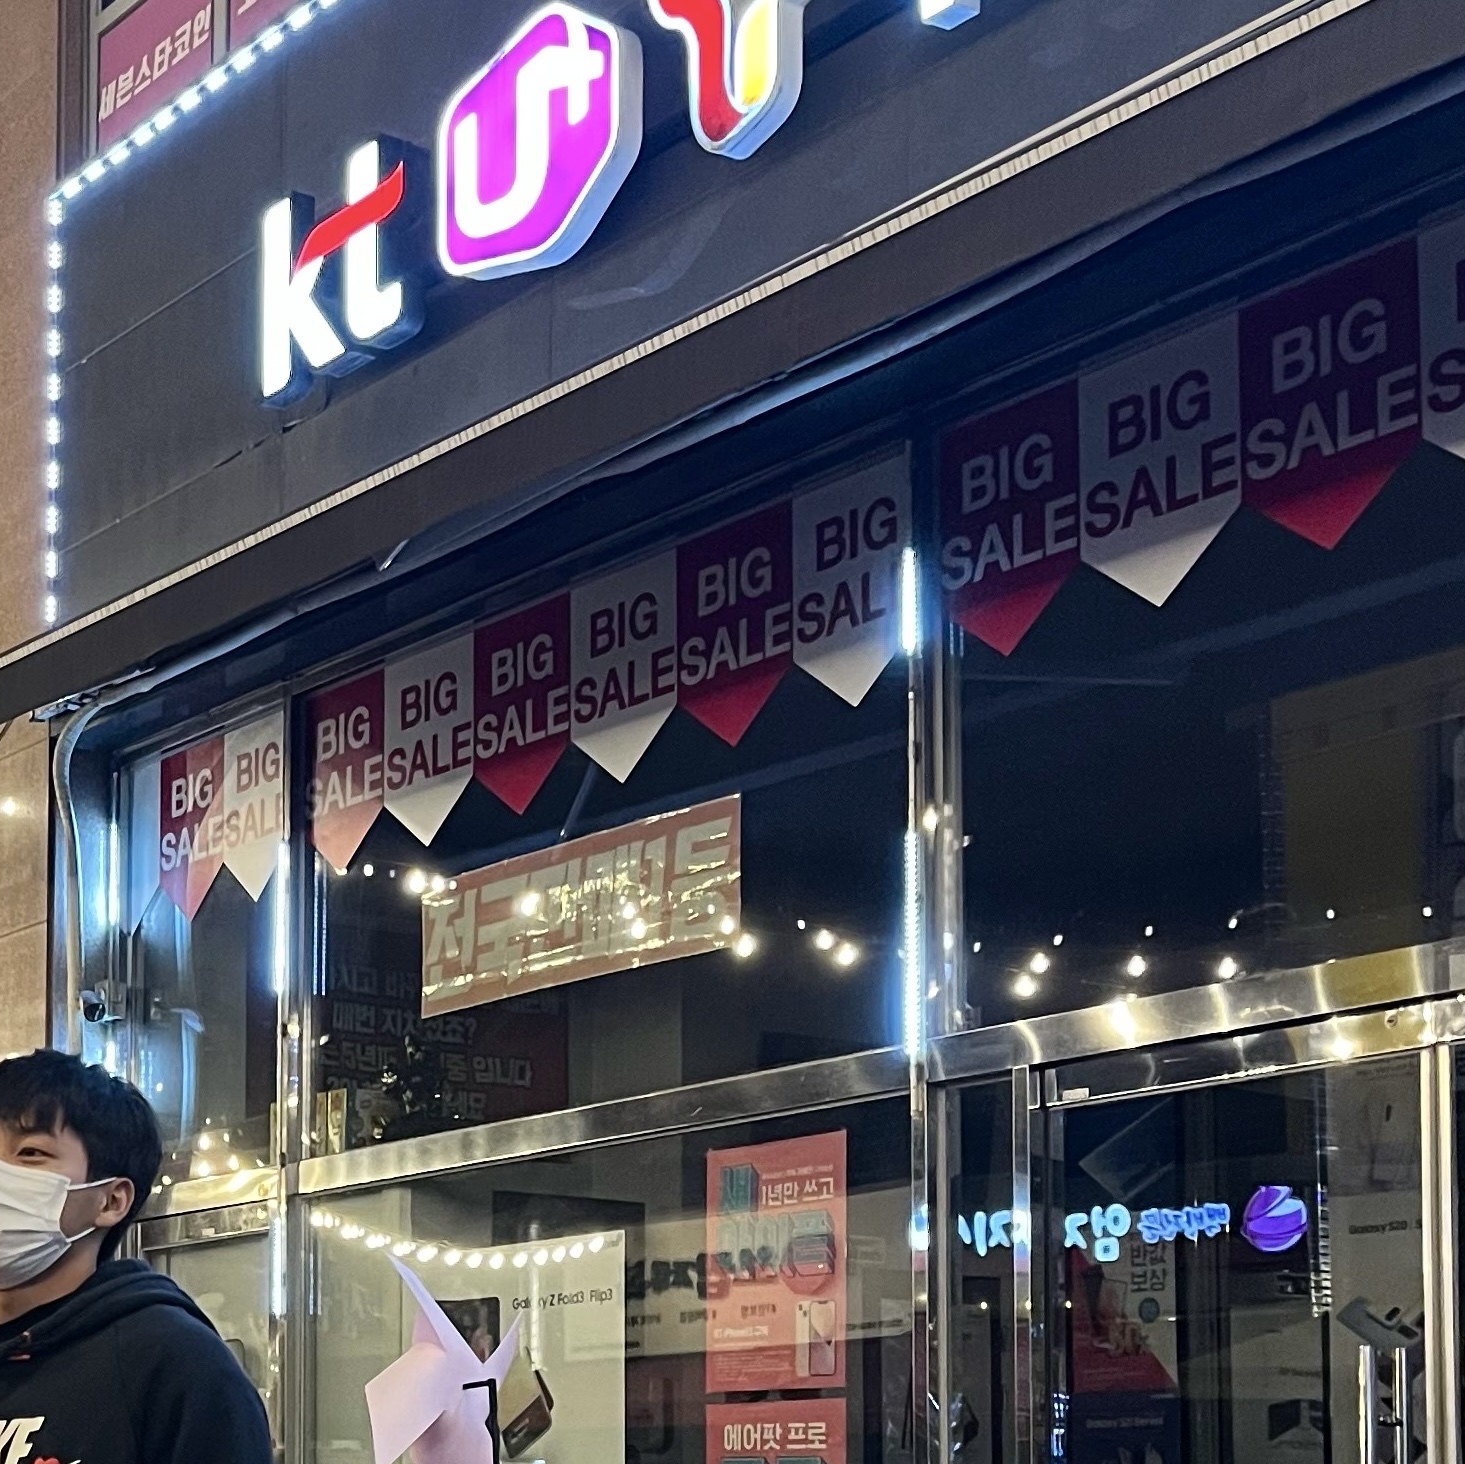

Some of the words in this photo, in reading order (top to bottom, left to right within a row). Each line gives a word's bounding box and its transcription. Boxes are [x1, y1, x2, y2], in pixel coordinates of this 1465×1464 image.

[261, 140, 405, 399] kt
[1272, 298, 1388, 393] BIG
[1107, 369, 1212, 458] BIG
[1244, 363, 1419, 480] SALE
[961, 433, 1054, 514] BIG
[1085, 430, 1241, 539] SALE
[814, 497, 899, 572] BIG
[941, 500, 1078, 592] SALE
[697, 547, 772, 616] BIG
[796, 572, 888, 644] SAL
[591, 592, 658, 656] BIG
[680, 607, 791, 685] SALE
[491, 633, 554, 696] BIG
[573, 646, 675, 725] SALE
[316, 705, 370, 763] BIG
[400, 671, 458, 730] BIG
[475, 690, 570, 760] SALE
[171, 767, 214, 819] BIG
[236, 741, 280, 793] BIG
[307, 753, 383, 829] SALE
[386, 727, 474, 791] SALE
[161, 815, 224, 873] SALE
[802, 1177, 834, 1202] 쓰고
[723, 1423, 782, 1451] 에어팟
[786, 1422, 827, 1450] 프로
